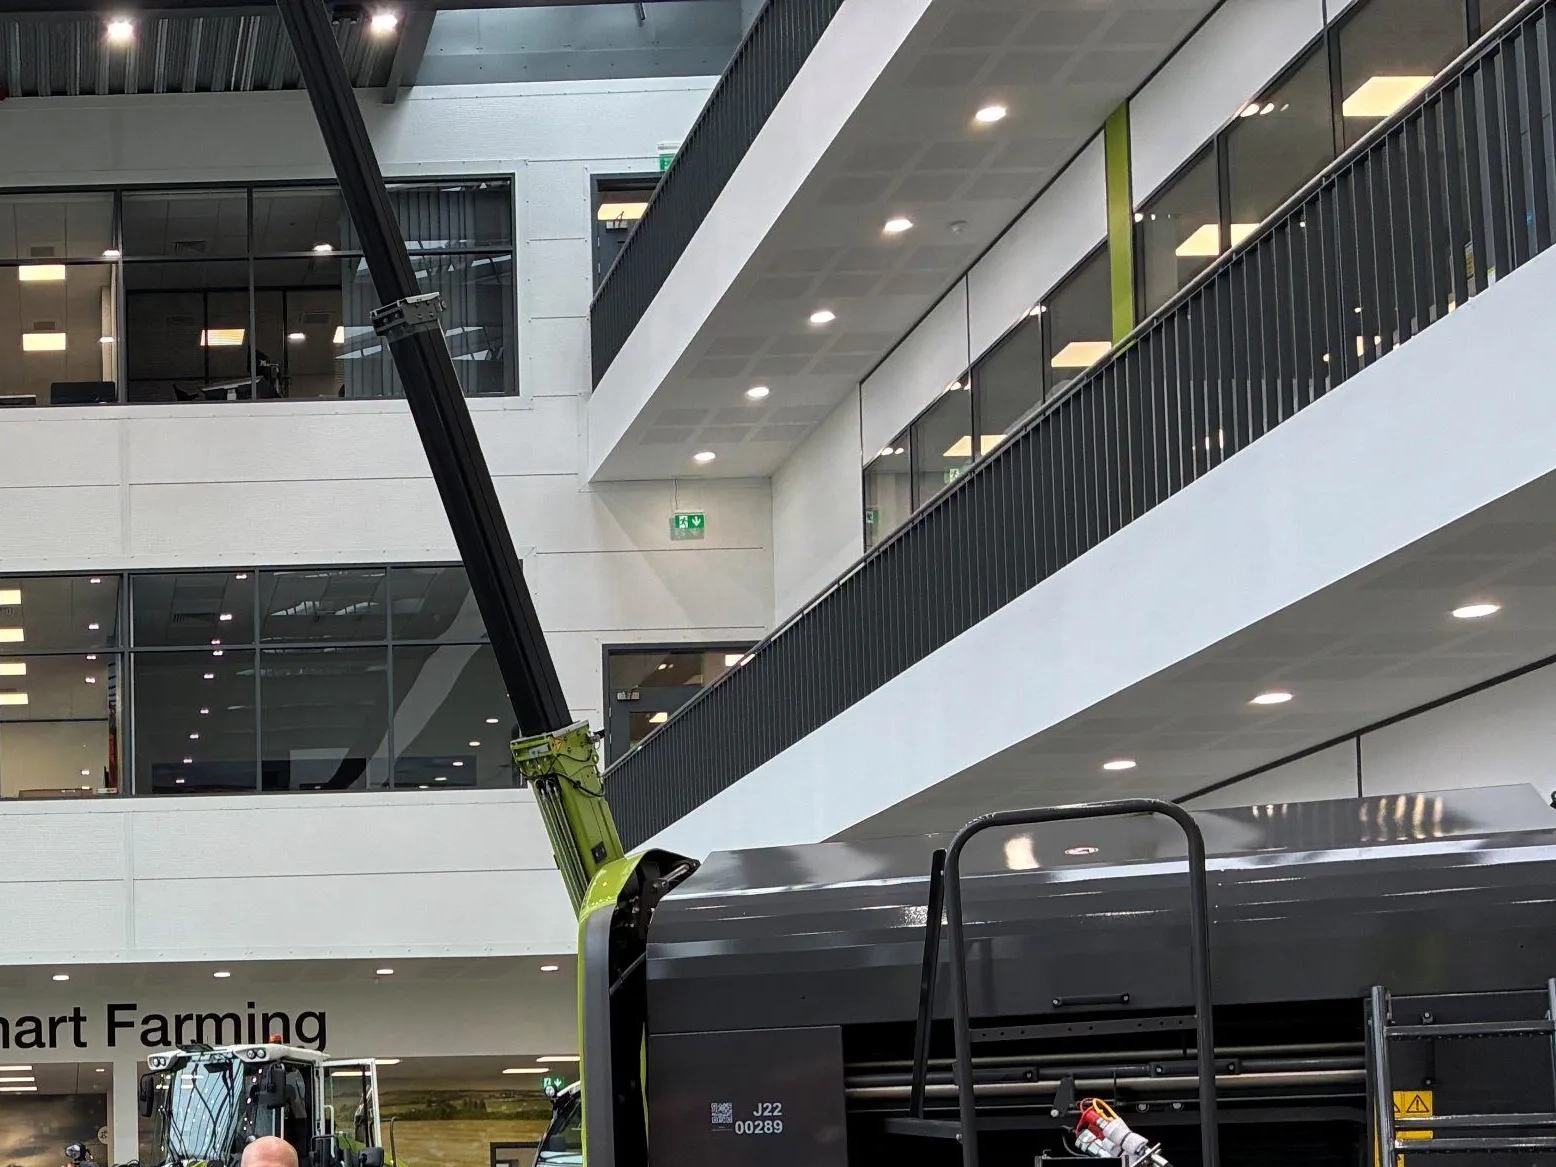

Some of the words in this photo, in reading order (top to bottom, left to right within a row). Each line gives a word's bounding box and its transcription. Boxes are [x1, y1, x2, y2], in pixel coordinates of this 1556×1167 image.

[107, 1002, 327, 1051] Farming
[753, 1102, 783, 1117] J22
[735, 1120, 784, 1134] 00289
